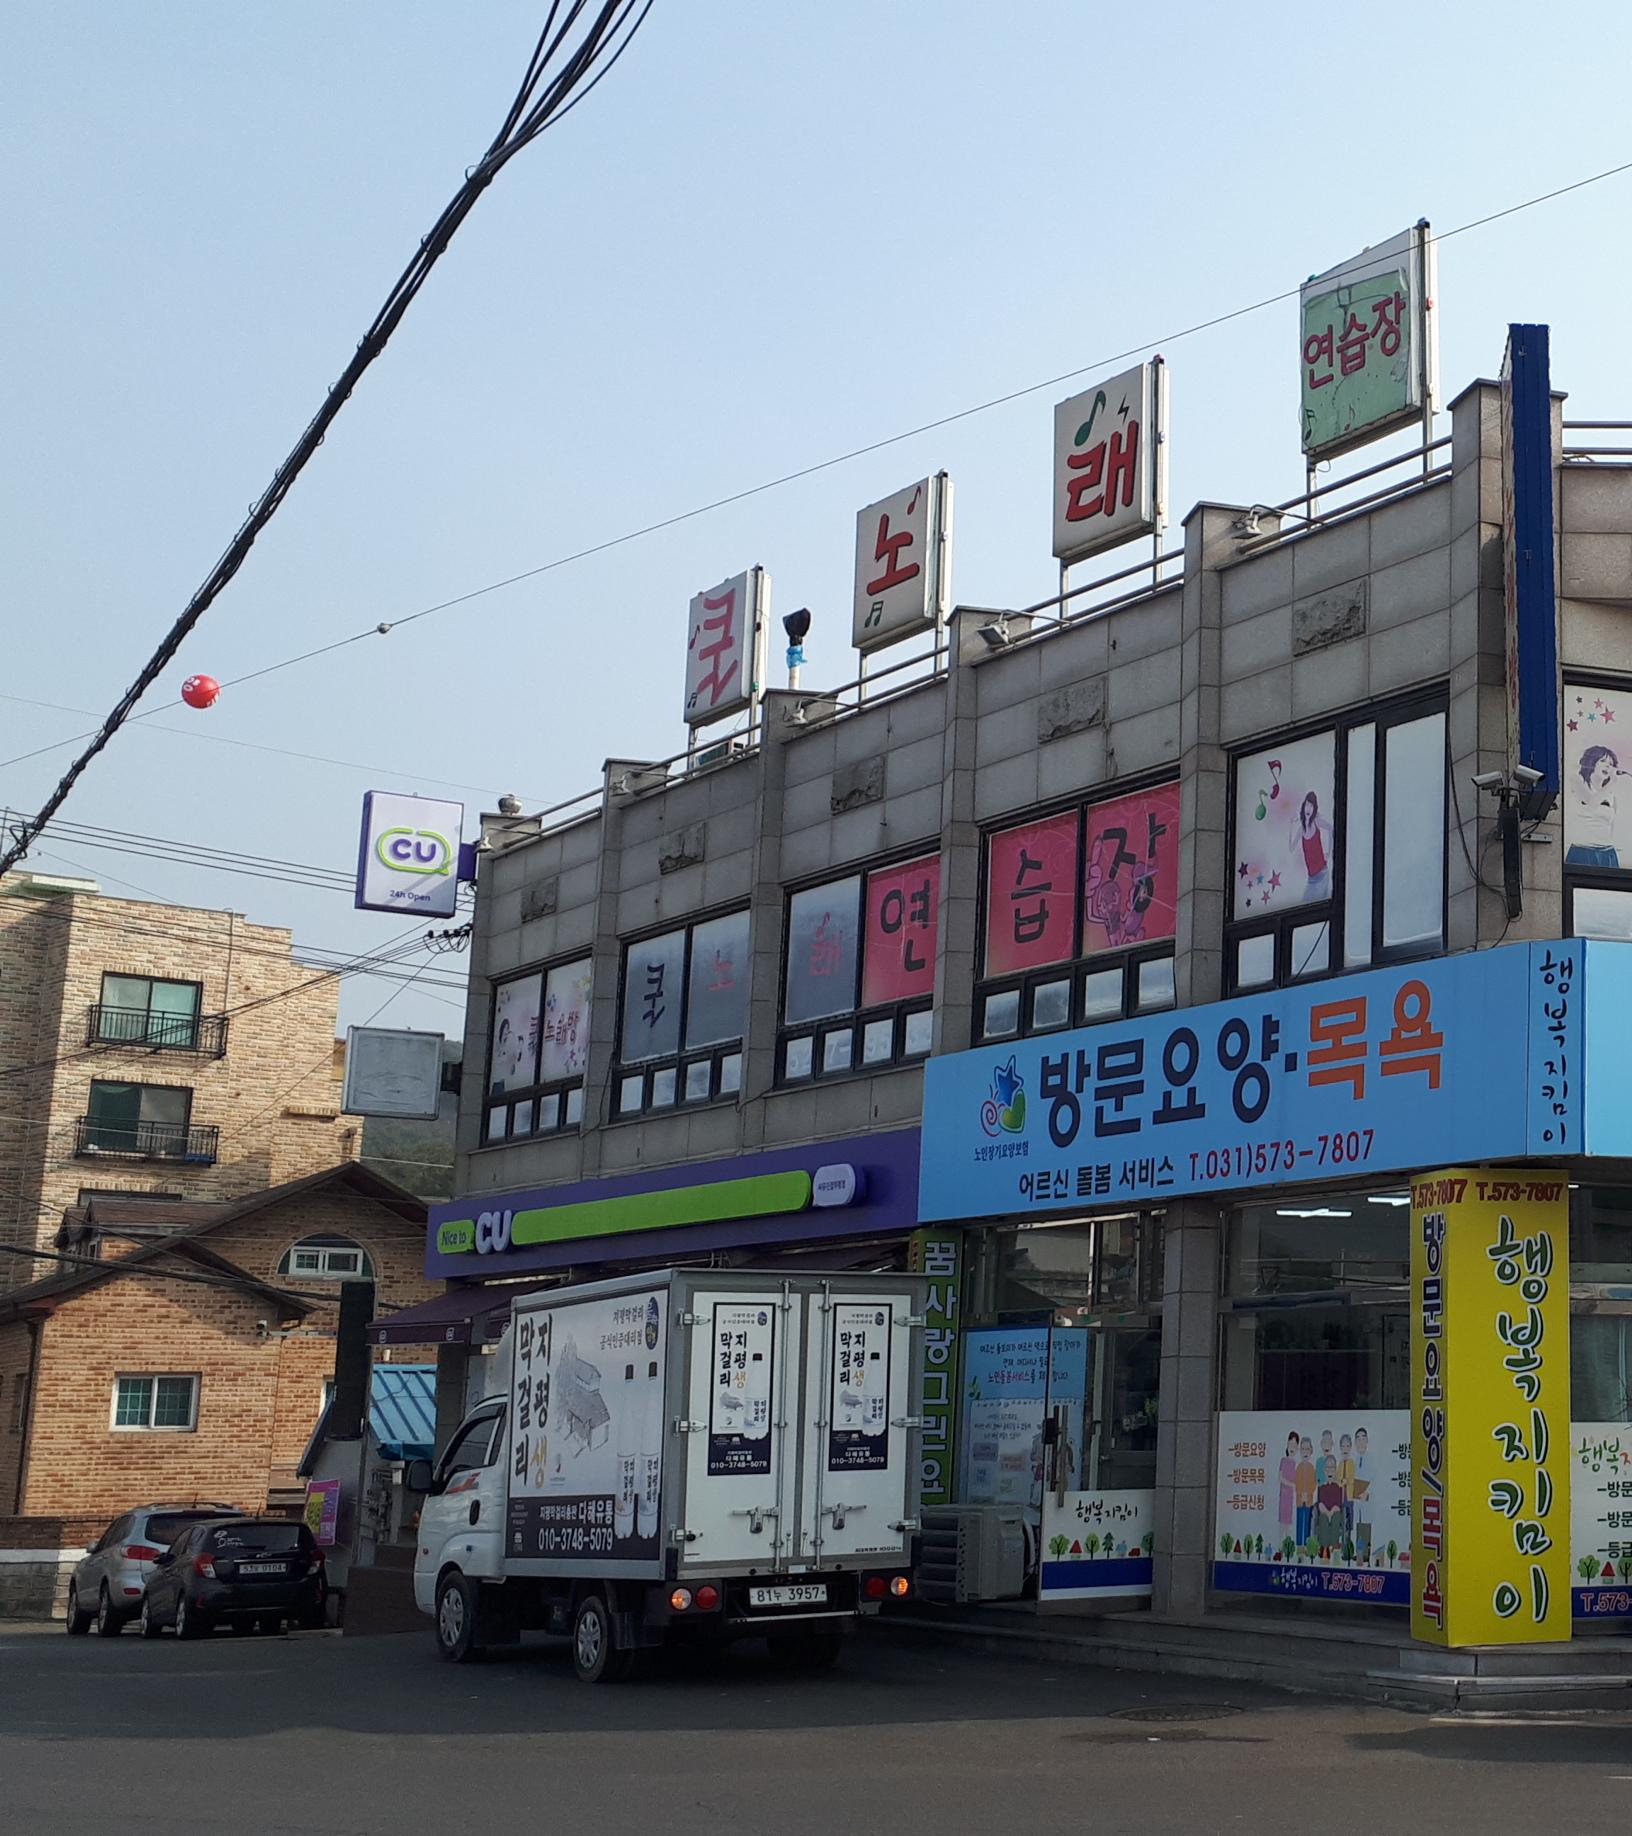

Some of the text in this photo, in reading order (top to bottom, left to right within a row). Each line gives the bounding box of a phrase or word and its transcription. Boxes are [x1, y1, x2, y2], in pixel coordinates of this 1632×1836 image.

[1303, 290, 1406, 390] 연습장
[1065, 419, 1140, 522] 래
[865, 512, 921, 597] 노
[391, 838, 437, 863] CU
[1011, 811, 1167, 945] 습 장
[390, 889, 431, 902] 24h Open
[879, 878, 930, 972] 연
[1538, 950, 1573, 1145] 행복지킴이
[974, 1141, 1029, 1162] 노인장기요양보험
[1019, 1128, 1376, 1203] 어르신 돌봄 서비스 T.031)573-7807
[1475, 1182, 1562, 1202] T.573-7807
[442, 1209, 512, 1254] Nice to CU
[720, 1331, 733, 1388] 막걸리
[840, 1331, 852, 1386] 막걸리
[515, 1316, 535, 1487] 막걸리
[1486, 1214, 1553, 1623] 행복지킴이
[538, 1527, 613, 1551] 010-3748-5079
[577, 1499, 614, 1525] 다해유통
[1076, 1499, 1139, 1525] 행복지킴이
[788, 1587, 820, 1601] 3957
[1321, 1572, 1386, 1595] T.573-7807
